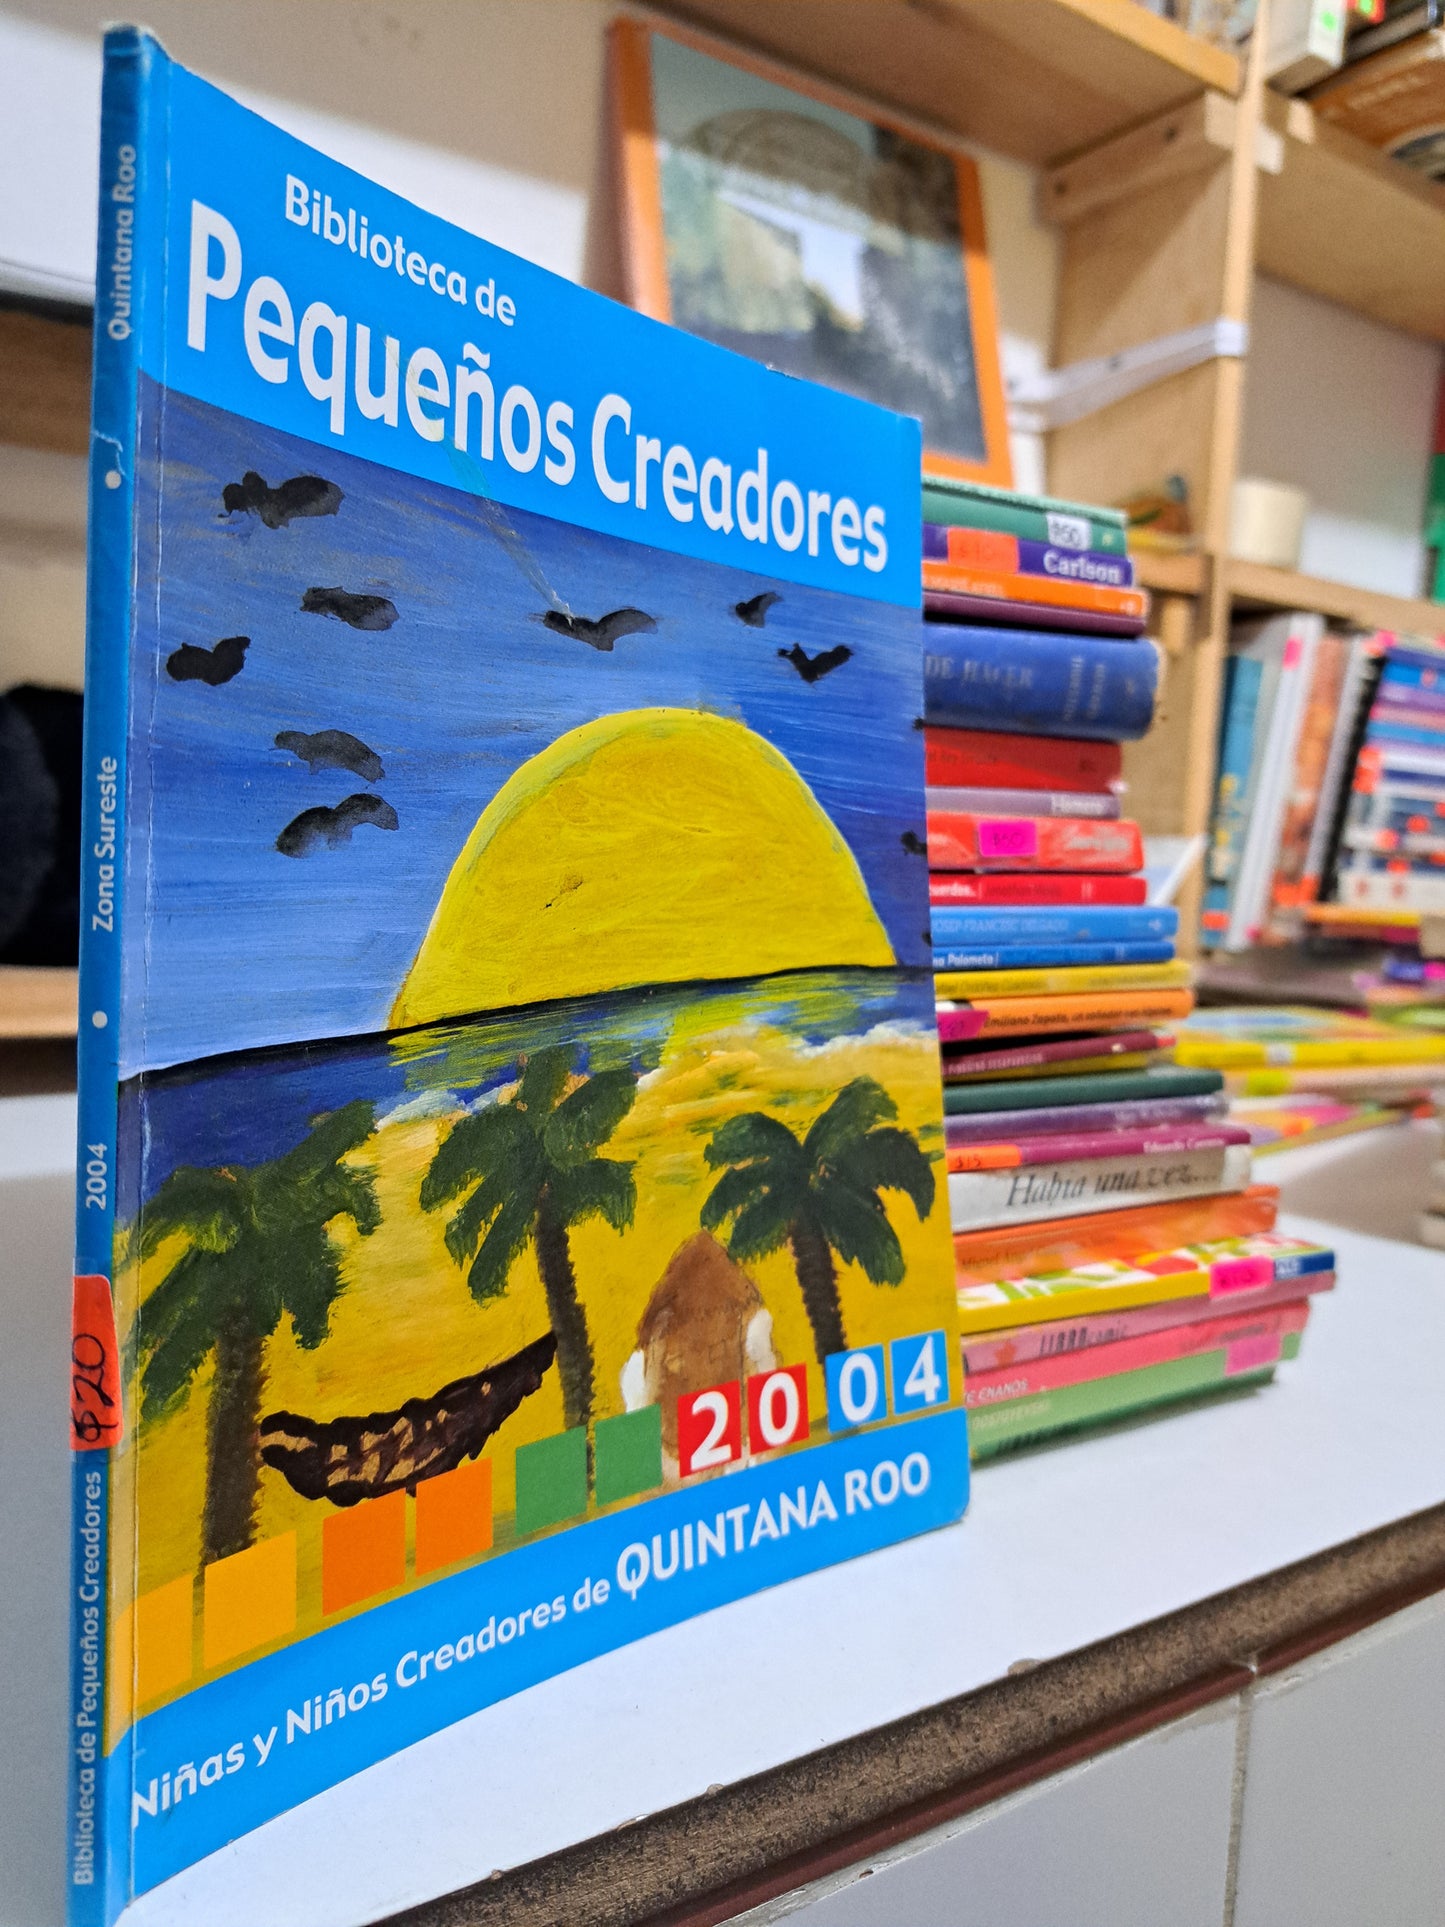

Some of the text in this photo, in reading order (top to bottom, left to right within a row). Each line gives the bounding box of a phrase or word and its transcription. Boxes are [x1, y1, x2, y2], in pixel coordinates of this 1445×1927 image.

[107, 144, 137, 341] Quintana Roo
[285, 173, 517, 327] Biblioteca de
[187, 199, 889, 573] Pequeños Creadores
[1043, 549, 1122, 585] Carlson
[92, 756, 118, 933] Zona Sureste
[85, 1142, 108, 1211] 2004
[1093, 1166, 1141, 1196] una
[71, 1333, 119, 1443] $20
[73, 1470, 103, 1886] Biblioteca de Pequeños Creadores
[132, 1451, 931, 1829] Niñas y Niños Creadores de QUINTANA ROO
